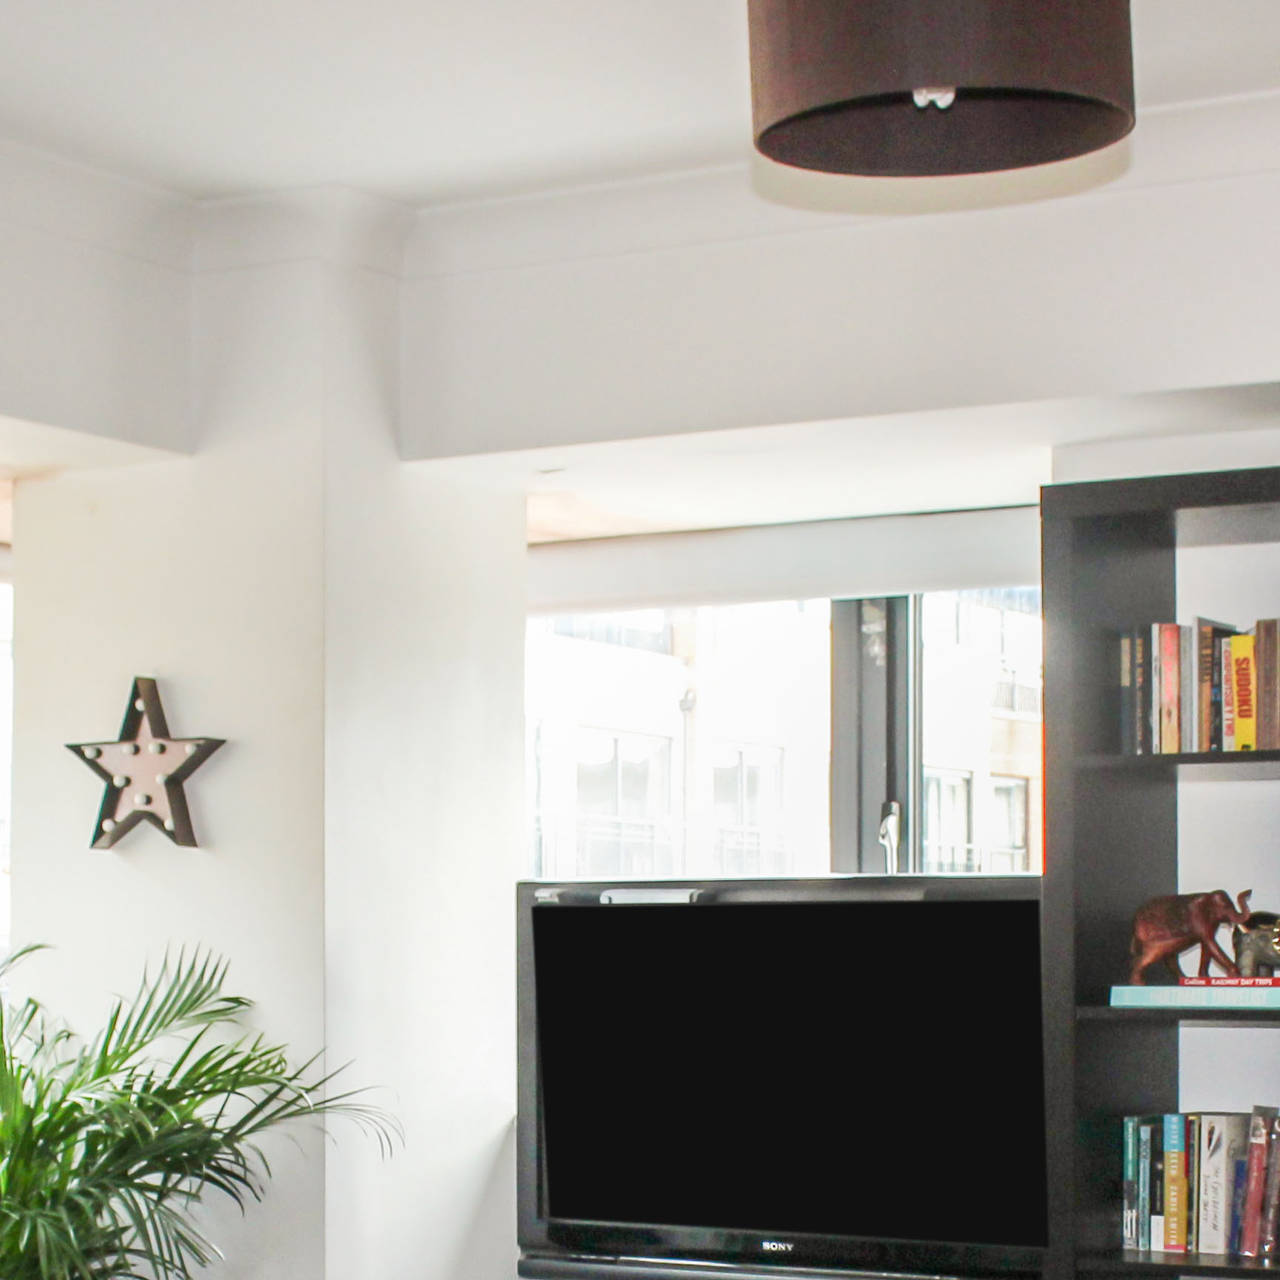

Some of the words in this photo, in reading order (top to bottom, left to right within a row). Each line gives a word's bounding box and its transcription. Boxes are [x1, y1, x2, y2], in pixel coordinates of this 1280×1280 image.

[1235, 657, 1254, 720] SUDOKU
[1169, 1116, 1179, 1145] WHITE
[1169, 1149, 1179, 1176] TEETH
[1169, 1185, 1179, 1212] ZADIE
[1169, 1216, 1179, 1246] SMITH
[762, 1241, 795, 1252] SONY
